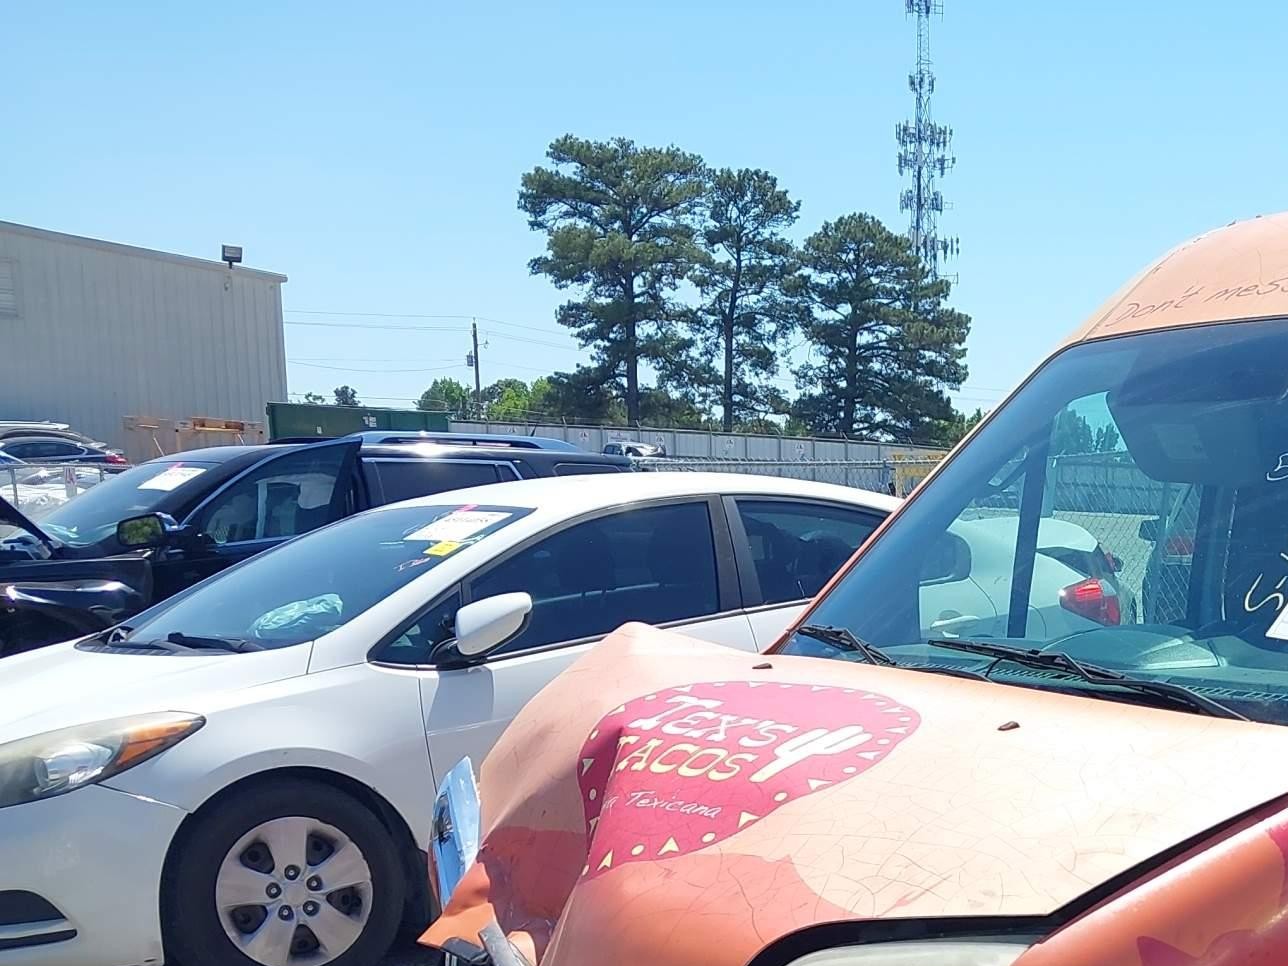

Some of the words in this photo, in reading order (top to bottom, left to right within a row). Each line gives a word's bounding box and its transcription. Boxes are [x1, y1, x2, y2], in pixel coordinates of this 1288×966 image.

[1108, 286, 1203, 327] Don't
[613, 735, 759, 782] TACOS
[624, 789, 723, 819] Texicana
